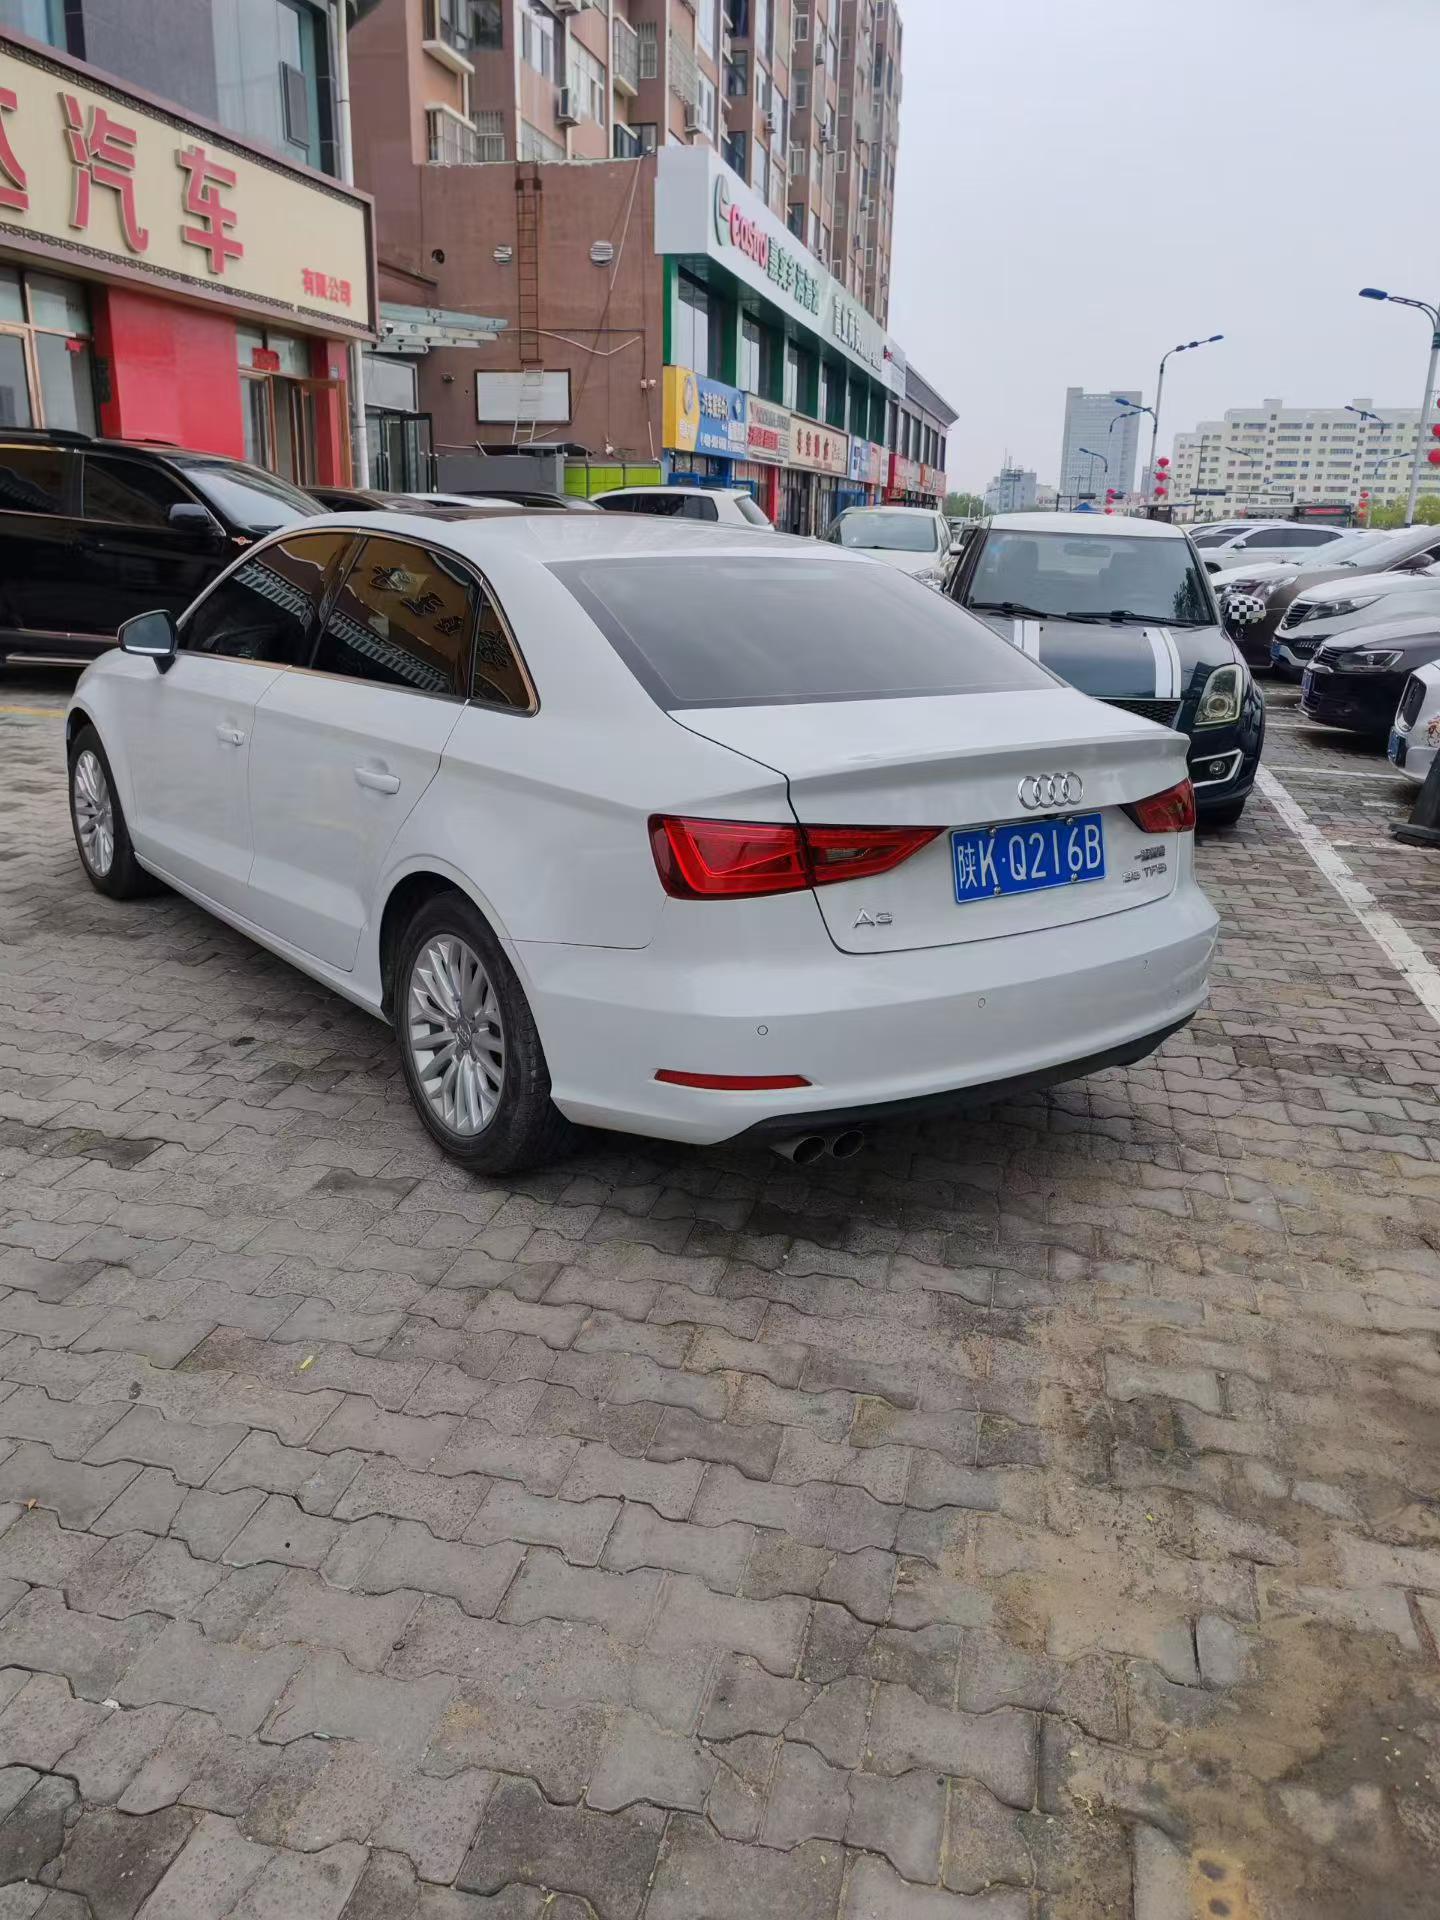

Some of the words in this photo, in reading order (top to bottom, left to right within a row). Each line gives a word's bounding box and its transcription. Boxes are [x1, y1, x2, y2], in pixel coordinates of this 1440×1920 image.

[302, 267, 352, 306] 有限公司
[853, 908, 892, 928] A3
